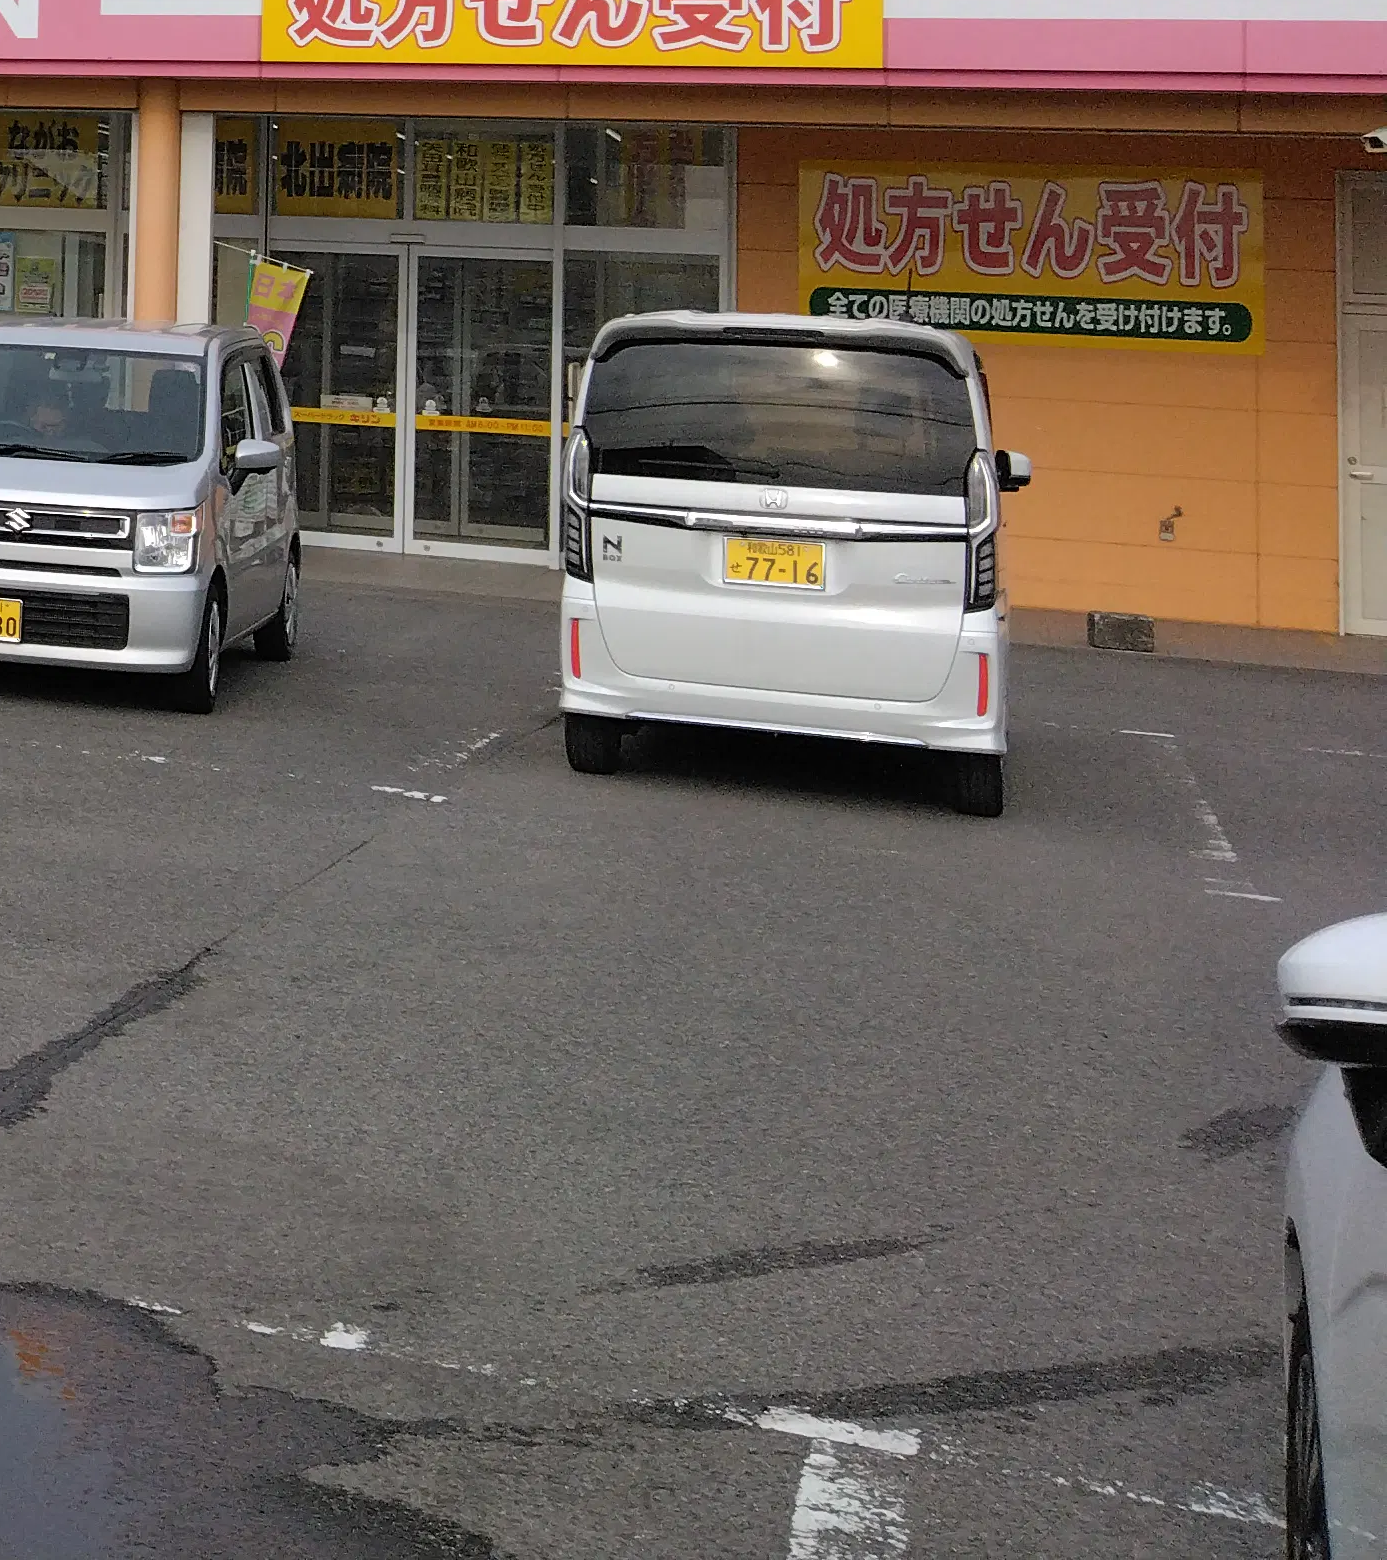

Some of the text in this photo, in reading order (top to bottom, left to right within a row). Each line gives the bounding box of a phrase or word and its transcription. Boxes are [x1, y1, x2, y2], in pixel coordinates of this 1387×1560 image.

[814, 172, 1249, 288] 処方せん受付
[827, 291, 1233, 336] 全ての医療機関の処方せんを受け付けます。
[602, 535, 623, 554] N
[602, 554, 623, 562] BOX
[729, 556, 819, 585] せ 77-16
